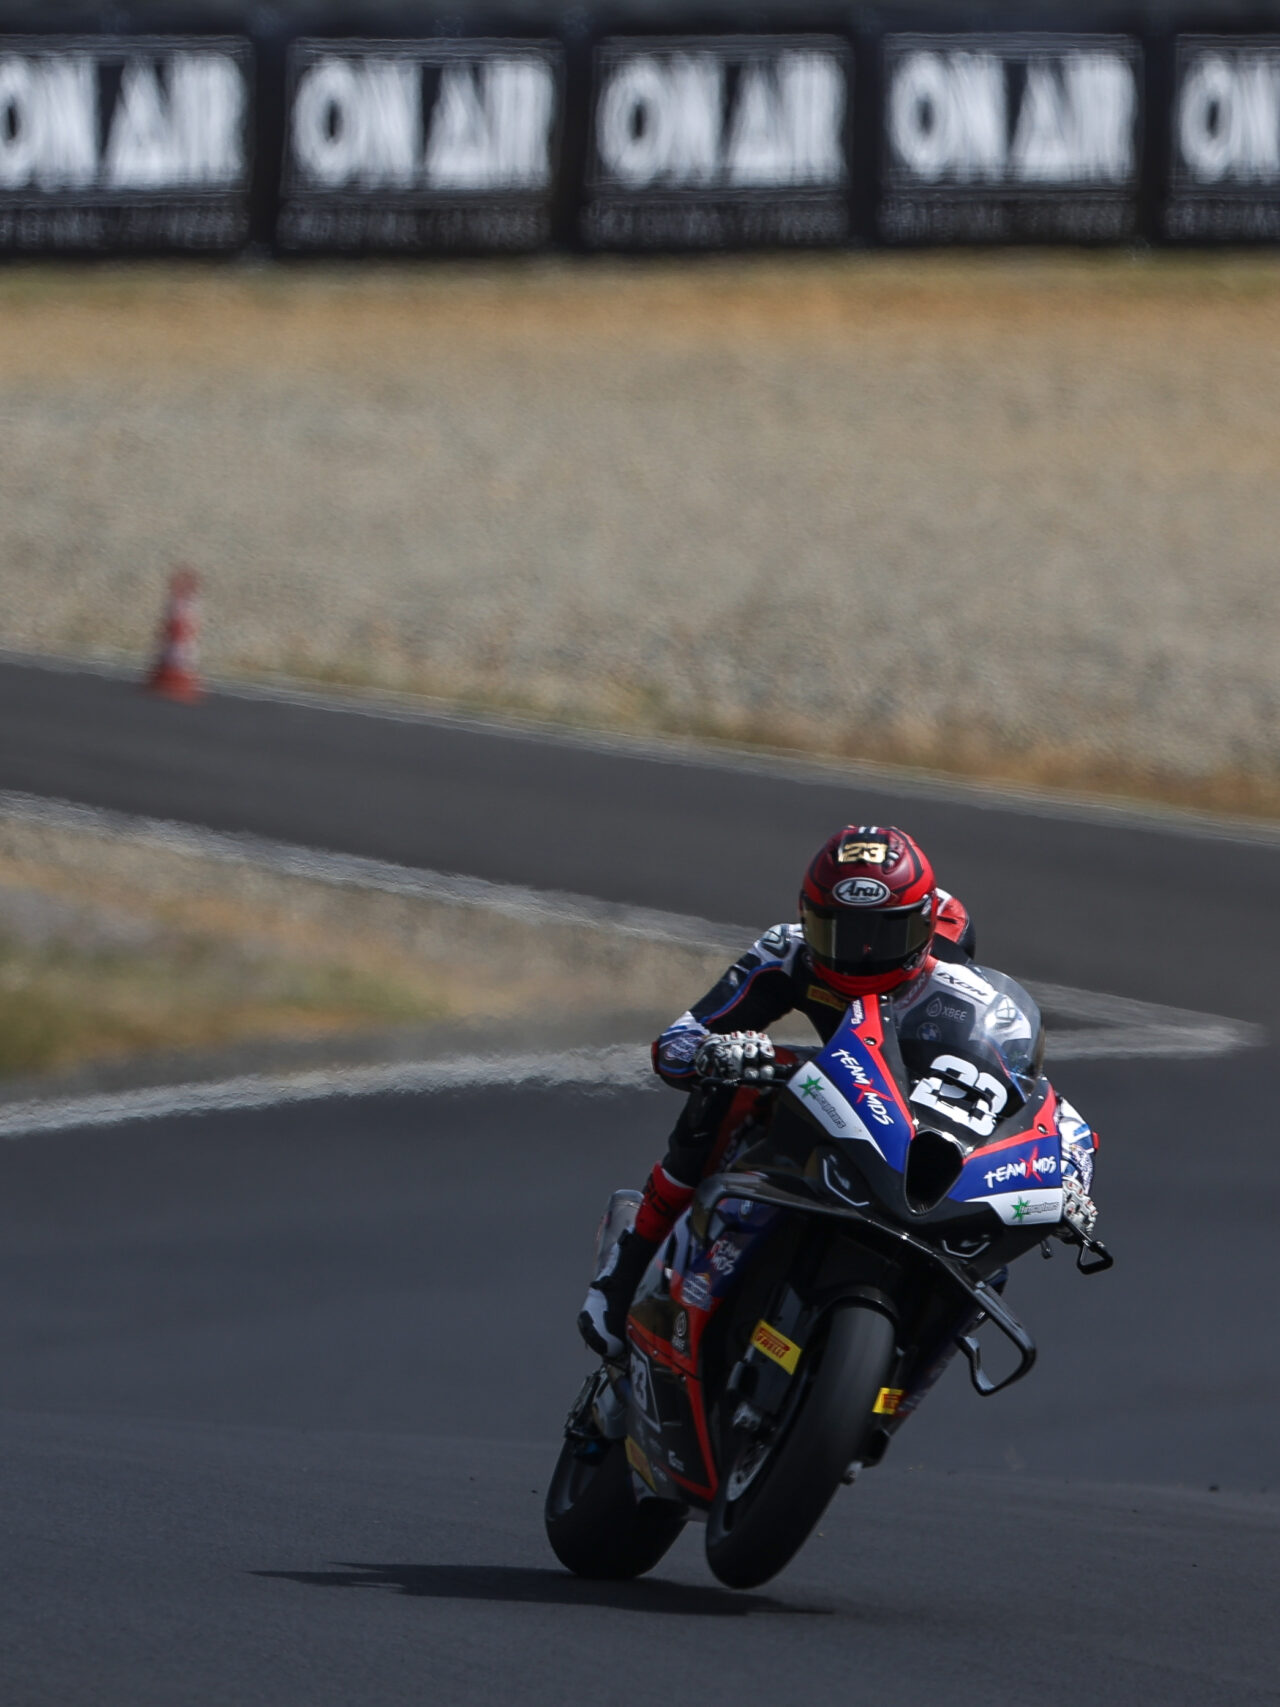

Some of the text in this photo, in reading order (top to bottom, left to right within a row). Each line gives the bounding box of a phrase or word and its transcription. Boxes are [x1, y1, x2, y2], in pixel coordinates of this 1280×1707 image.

[289, 56, 420, 190] ON
[594, 51, 720, 189] ON
[886, 50, 1007, 184] ON
[837, 879, 882, 899] Arai
